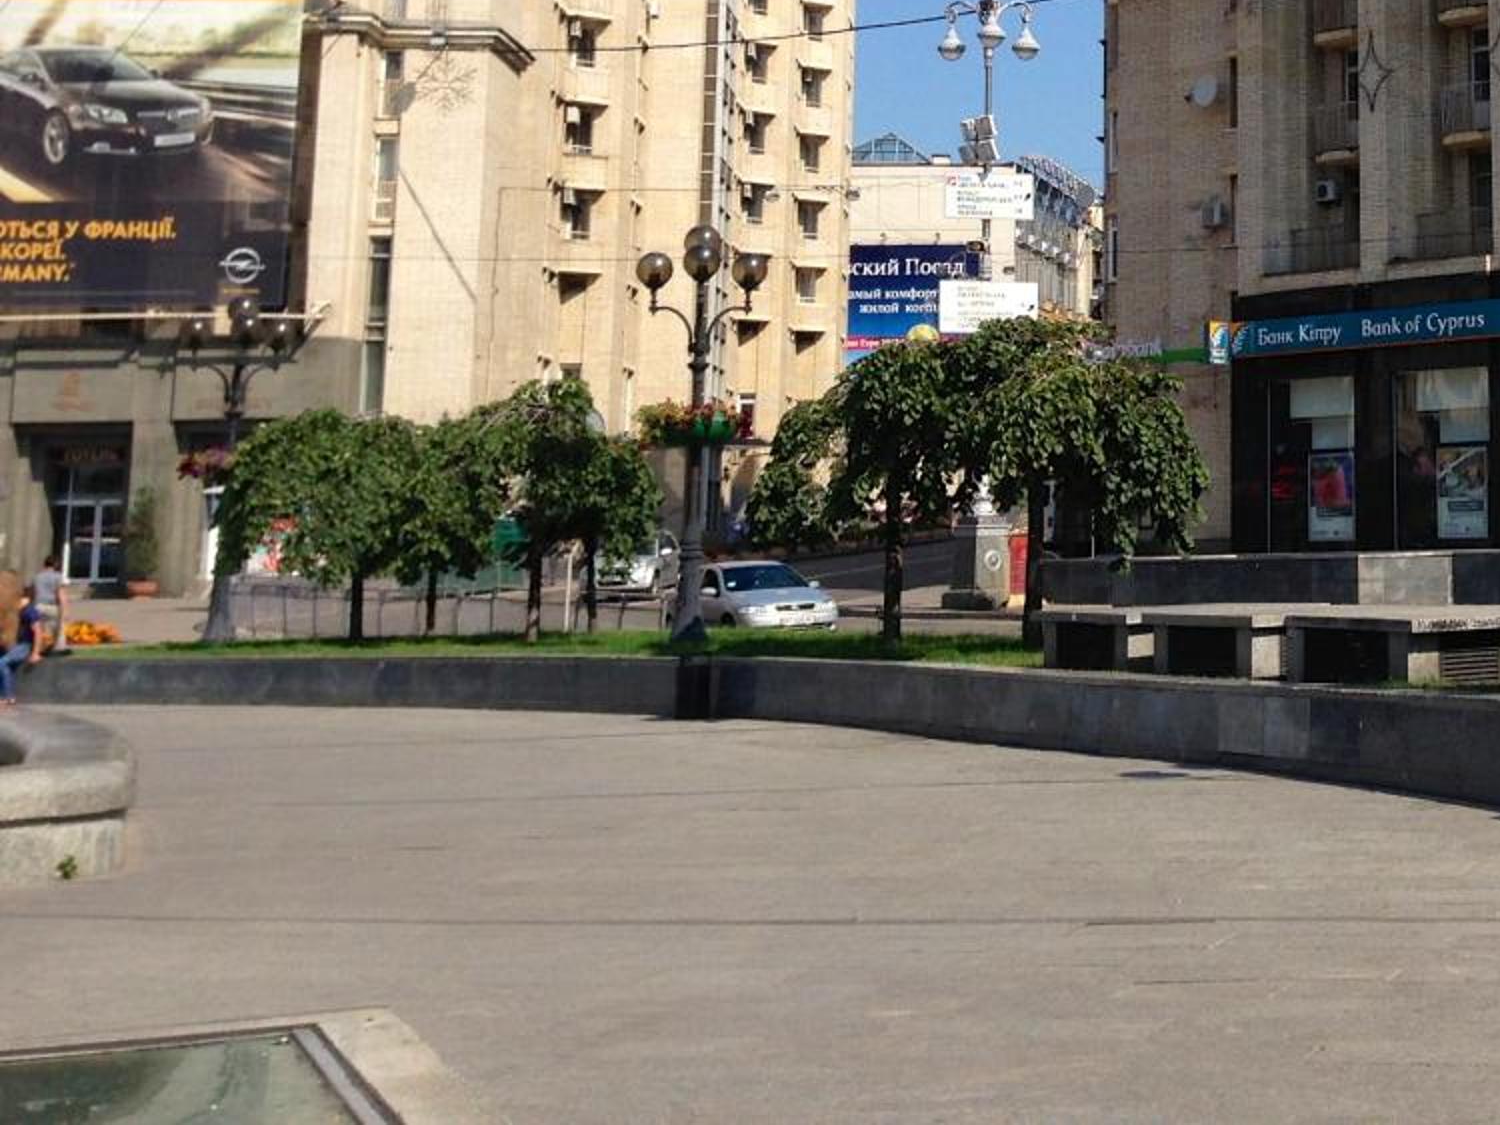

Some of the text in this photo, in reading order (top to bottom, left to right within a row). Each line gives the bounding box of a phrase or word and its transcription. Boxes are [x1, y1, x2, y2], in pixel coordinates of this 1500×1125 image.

[63, 220, 80, 239] У
[0, 263, 71, 282] MANY.
[848, 258, 899, 276] ский
[1360, 312, 1485, 337] Bank of Cyprus
[1257, 324, 1342, 347] Банк Кіпру
